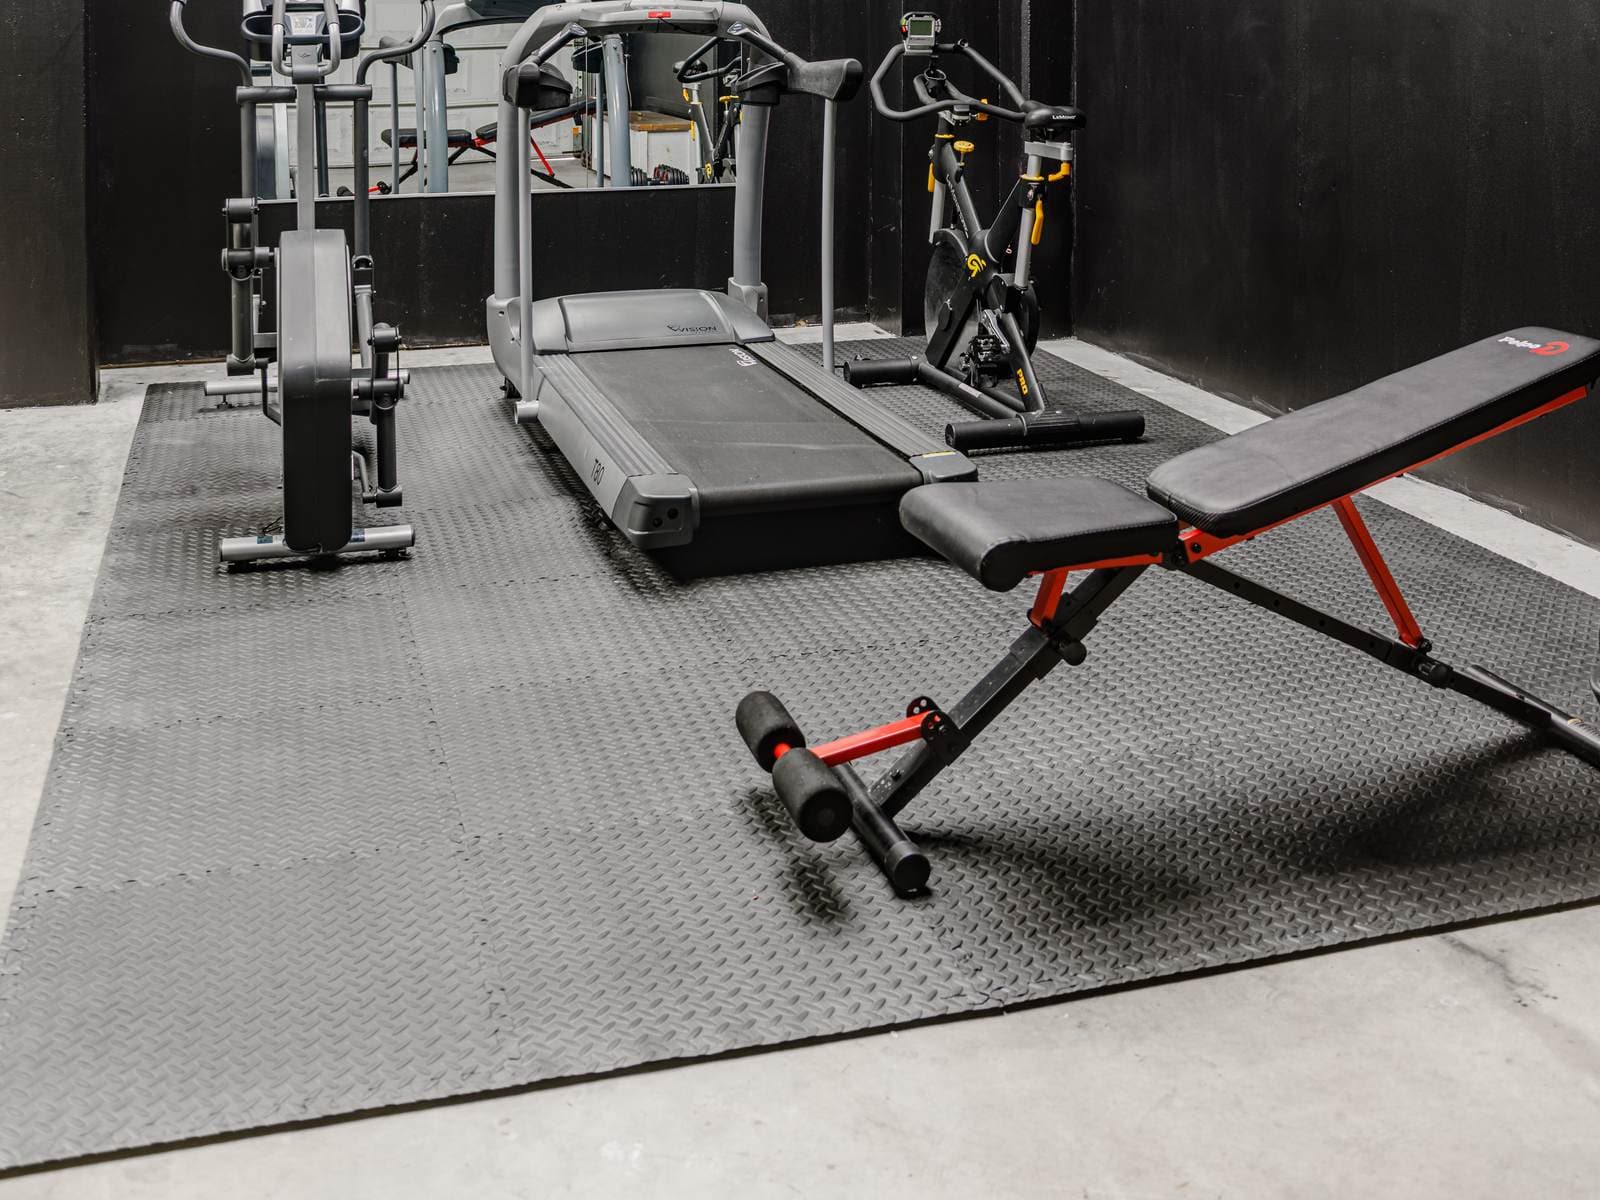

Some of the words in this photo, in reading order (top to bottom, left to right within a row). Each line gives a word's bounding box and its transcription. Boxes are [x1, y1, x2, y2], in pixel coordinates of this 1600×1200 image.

[666, 325, 717, 333] VISION
[728, 348, 758, 367] VISION
[1016, 367, 1028, 395] PRO
[591, 458, 605, 485] T80
